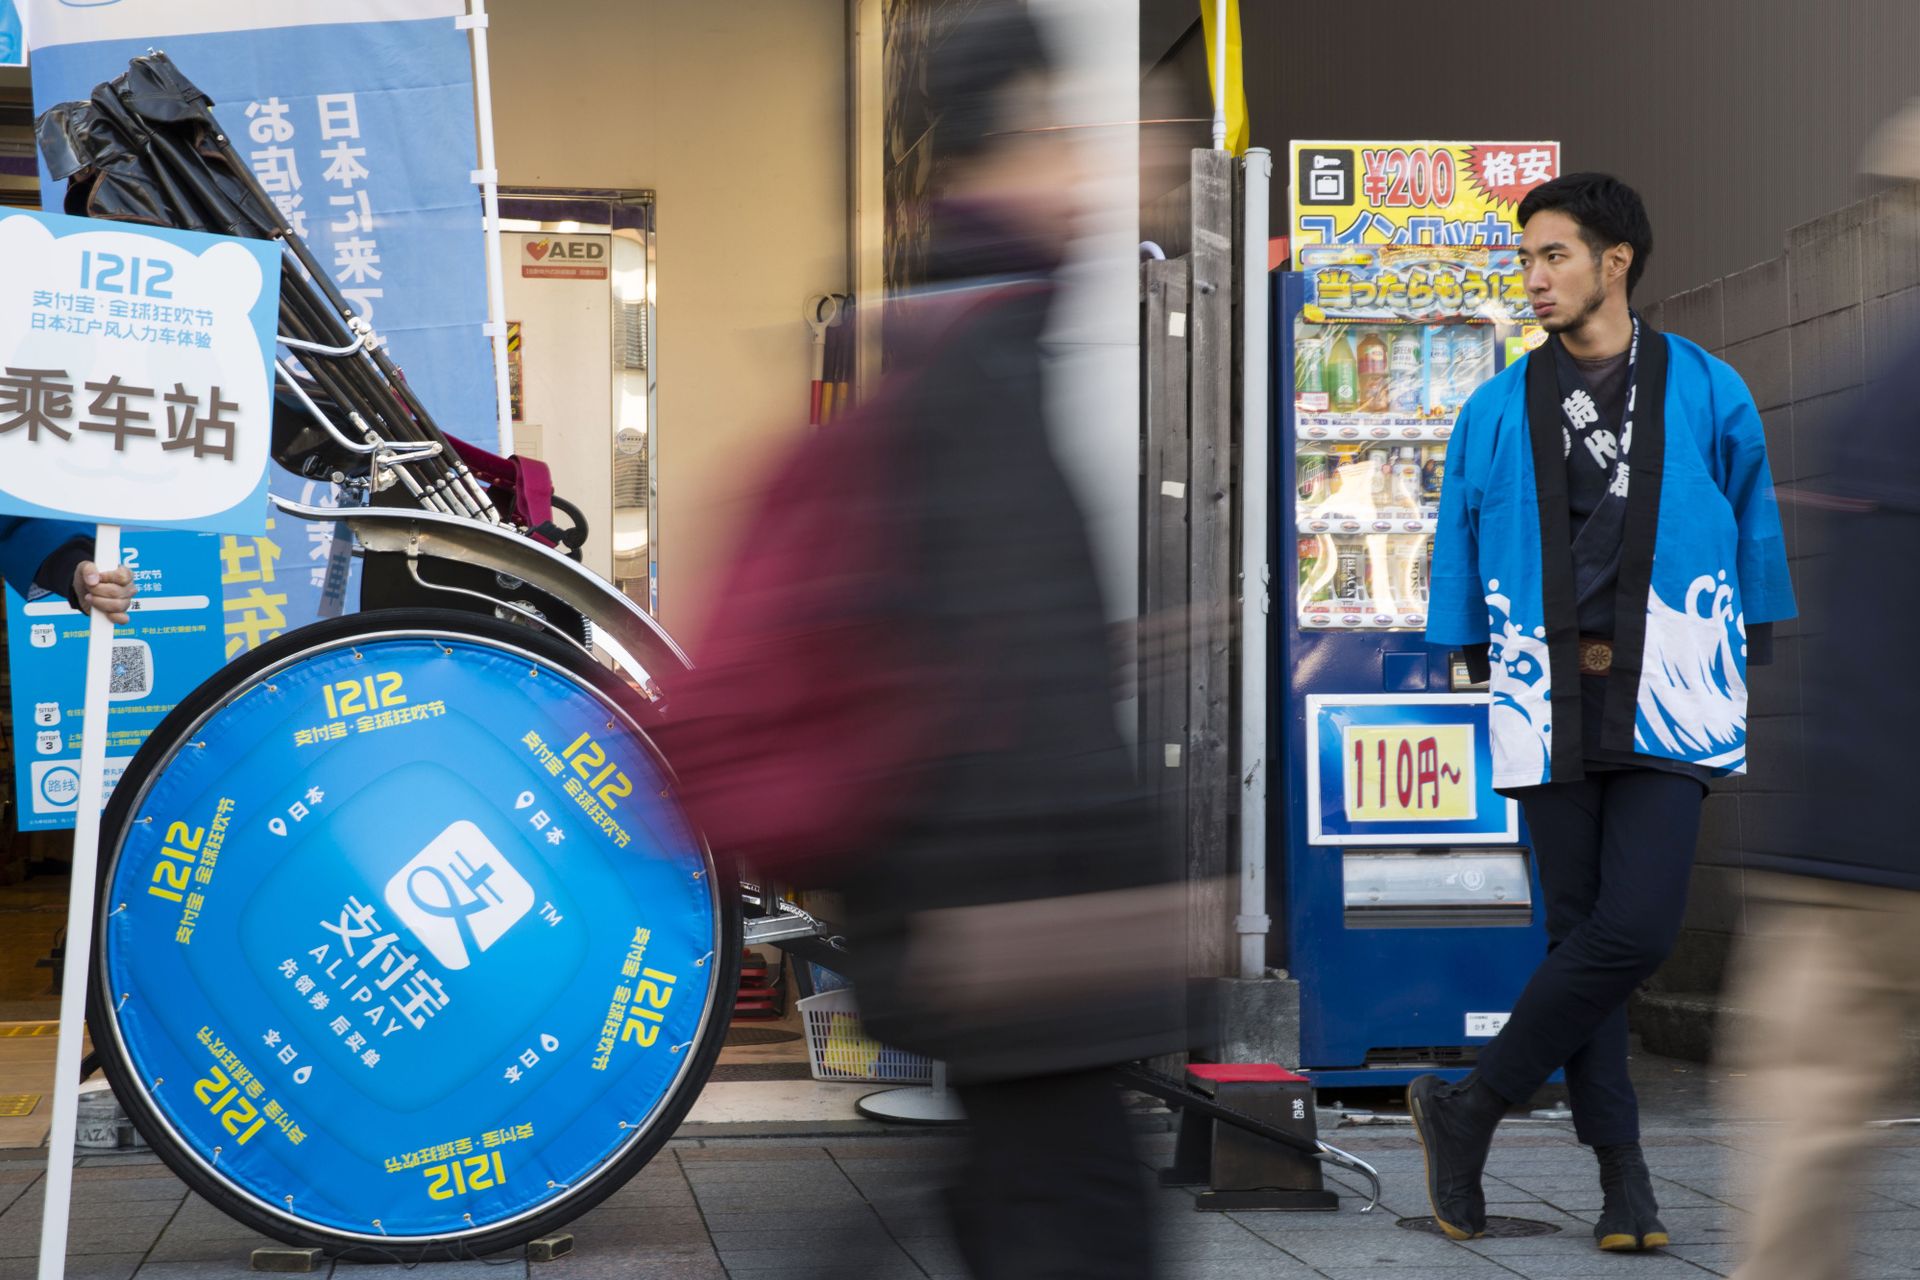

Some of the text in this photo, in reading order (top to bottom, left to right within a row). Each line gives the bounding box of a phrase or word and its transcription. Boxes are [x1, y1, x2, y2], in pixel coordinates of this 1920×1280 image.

[1363, 149, 1455, 208] ¥200
[1483, 149, 1553, 187] 格安
[548, 241, 604, 258] AED
[80, 250, 174, 299] 1212
[33, 290, 214, 327] 支付宝·全球狂欢节
[31, 312, 212, 349] 日本江户风人力车体验
[0, 366, 239, 462] 乘车站
[323, 671, 407, 718] 1212
[44, 713, 52, 722] 2
[294, 700, 447, 747] 支付宝·全球狂欢节
[46, 742, 53, 750] 3
[47, 780, 76, 793] 路线
[561, 731, 633, 810] 1212
[288, 786, 325, 821] 日本
[530, 809, 566, 846] 日本
[148, 820, 204, 903] 1212
[539, 901, 563, 926] TM
[320, 895, 450, 1030] 支付宝
[308, 943, 404, 1038] ALIPAY
[621, 967, 677, 1048] 1212
[262, 1028, 298, 1065] 日本
[504, 1048, 540, 1083] 日本
[194, 1065, 266, 1146] 1212
[423, 1151, 507, 1201] 1212
